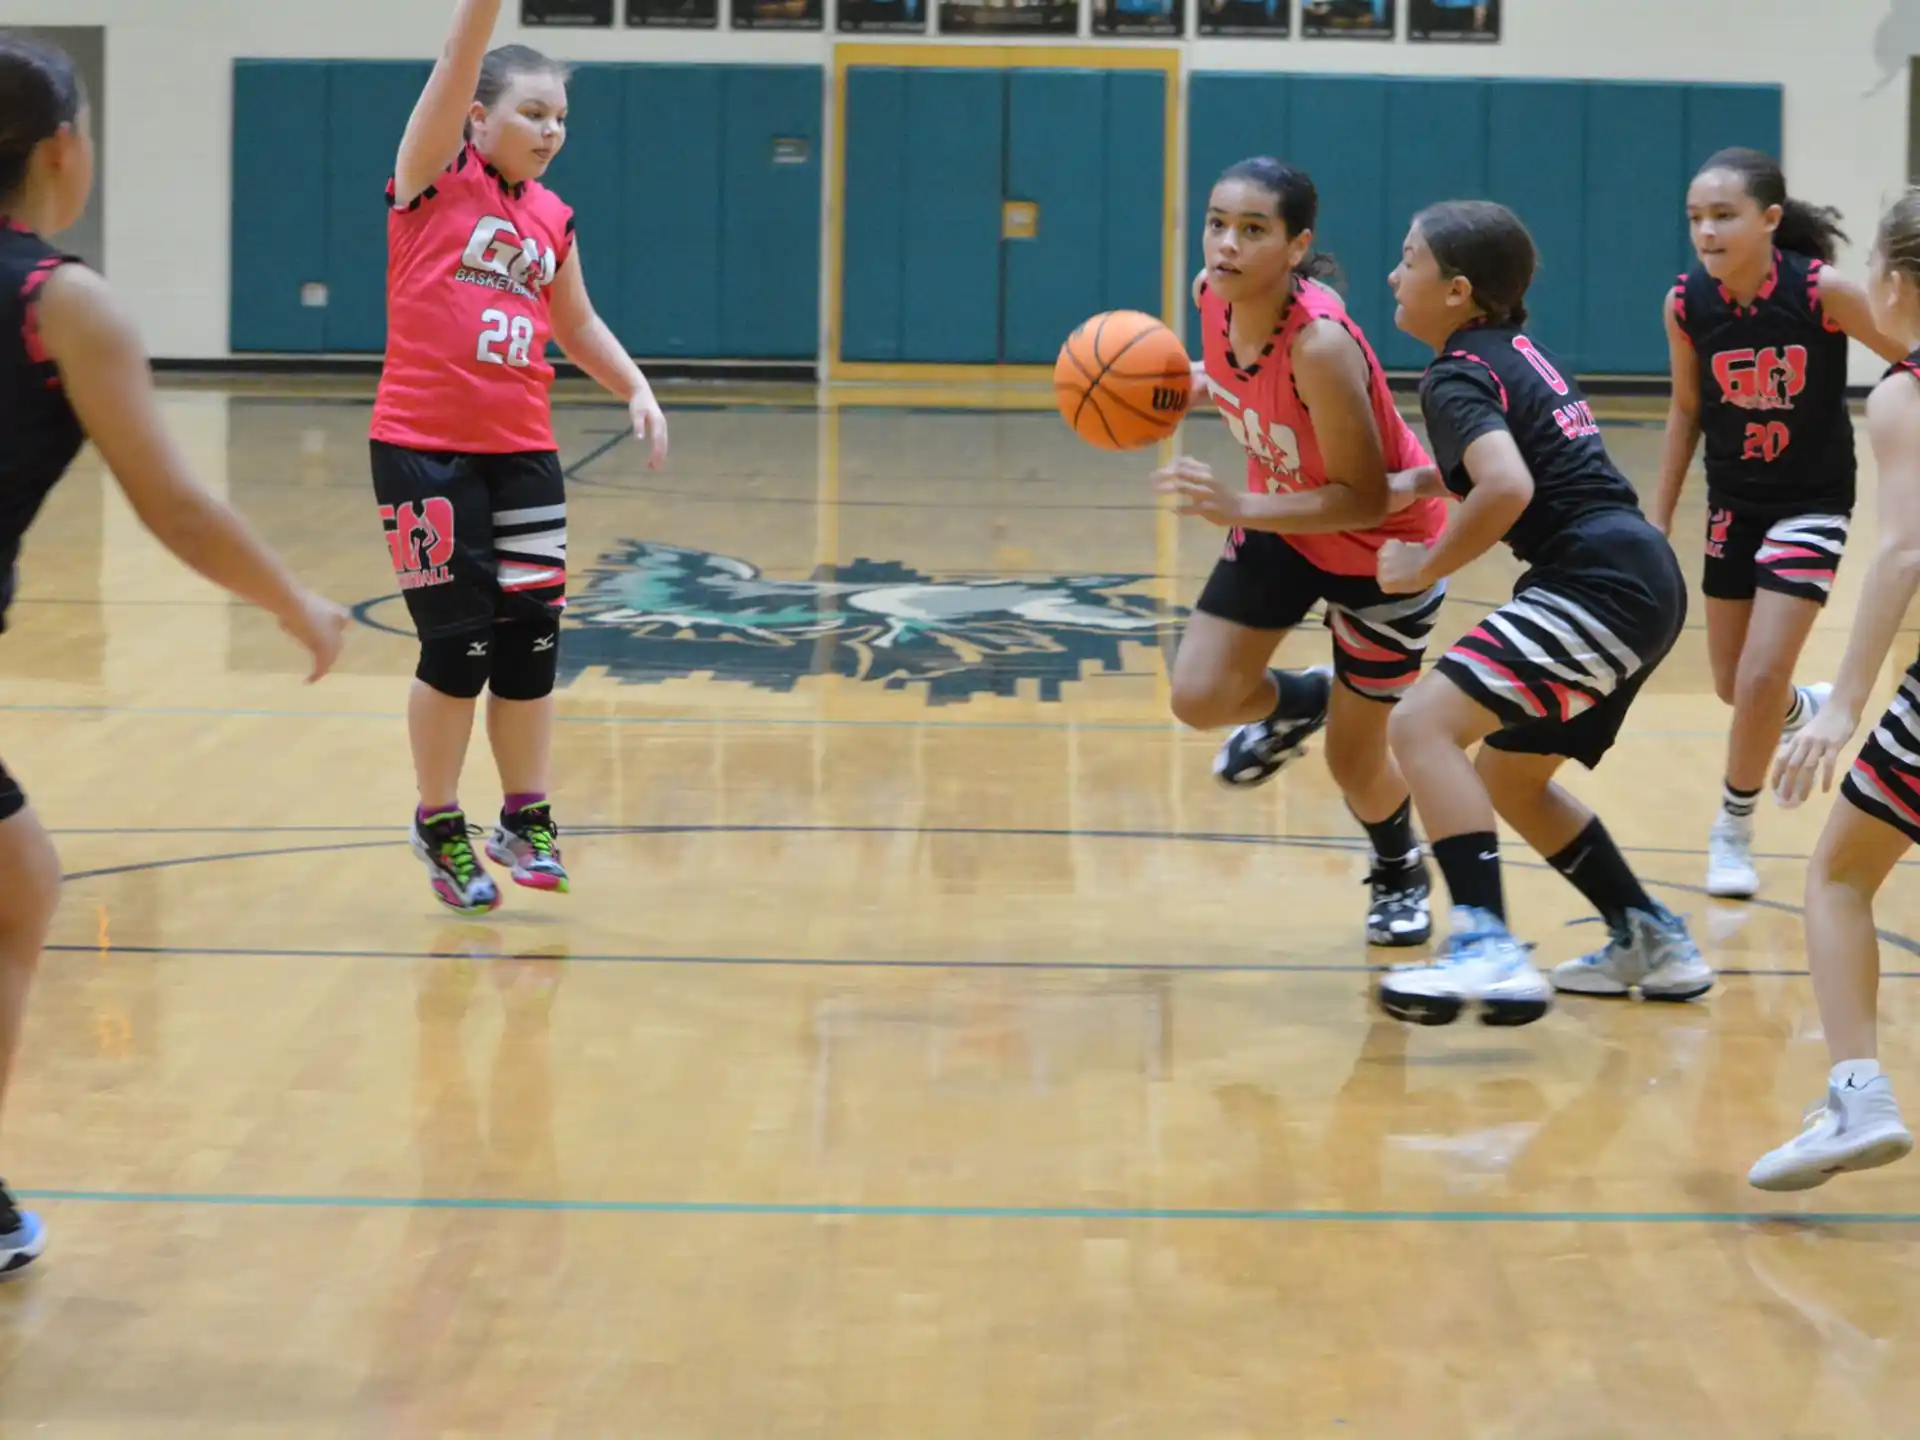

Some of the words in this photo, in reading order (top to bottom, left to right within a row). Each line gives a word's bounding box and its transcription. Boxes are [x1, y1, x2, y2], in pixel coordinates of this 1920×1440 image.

[476, 308, 534, 367] 28
[1512, 333, 1569, 396] 0
[1740, 420, 1790, 463] 20
